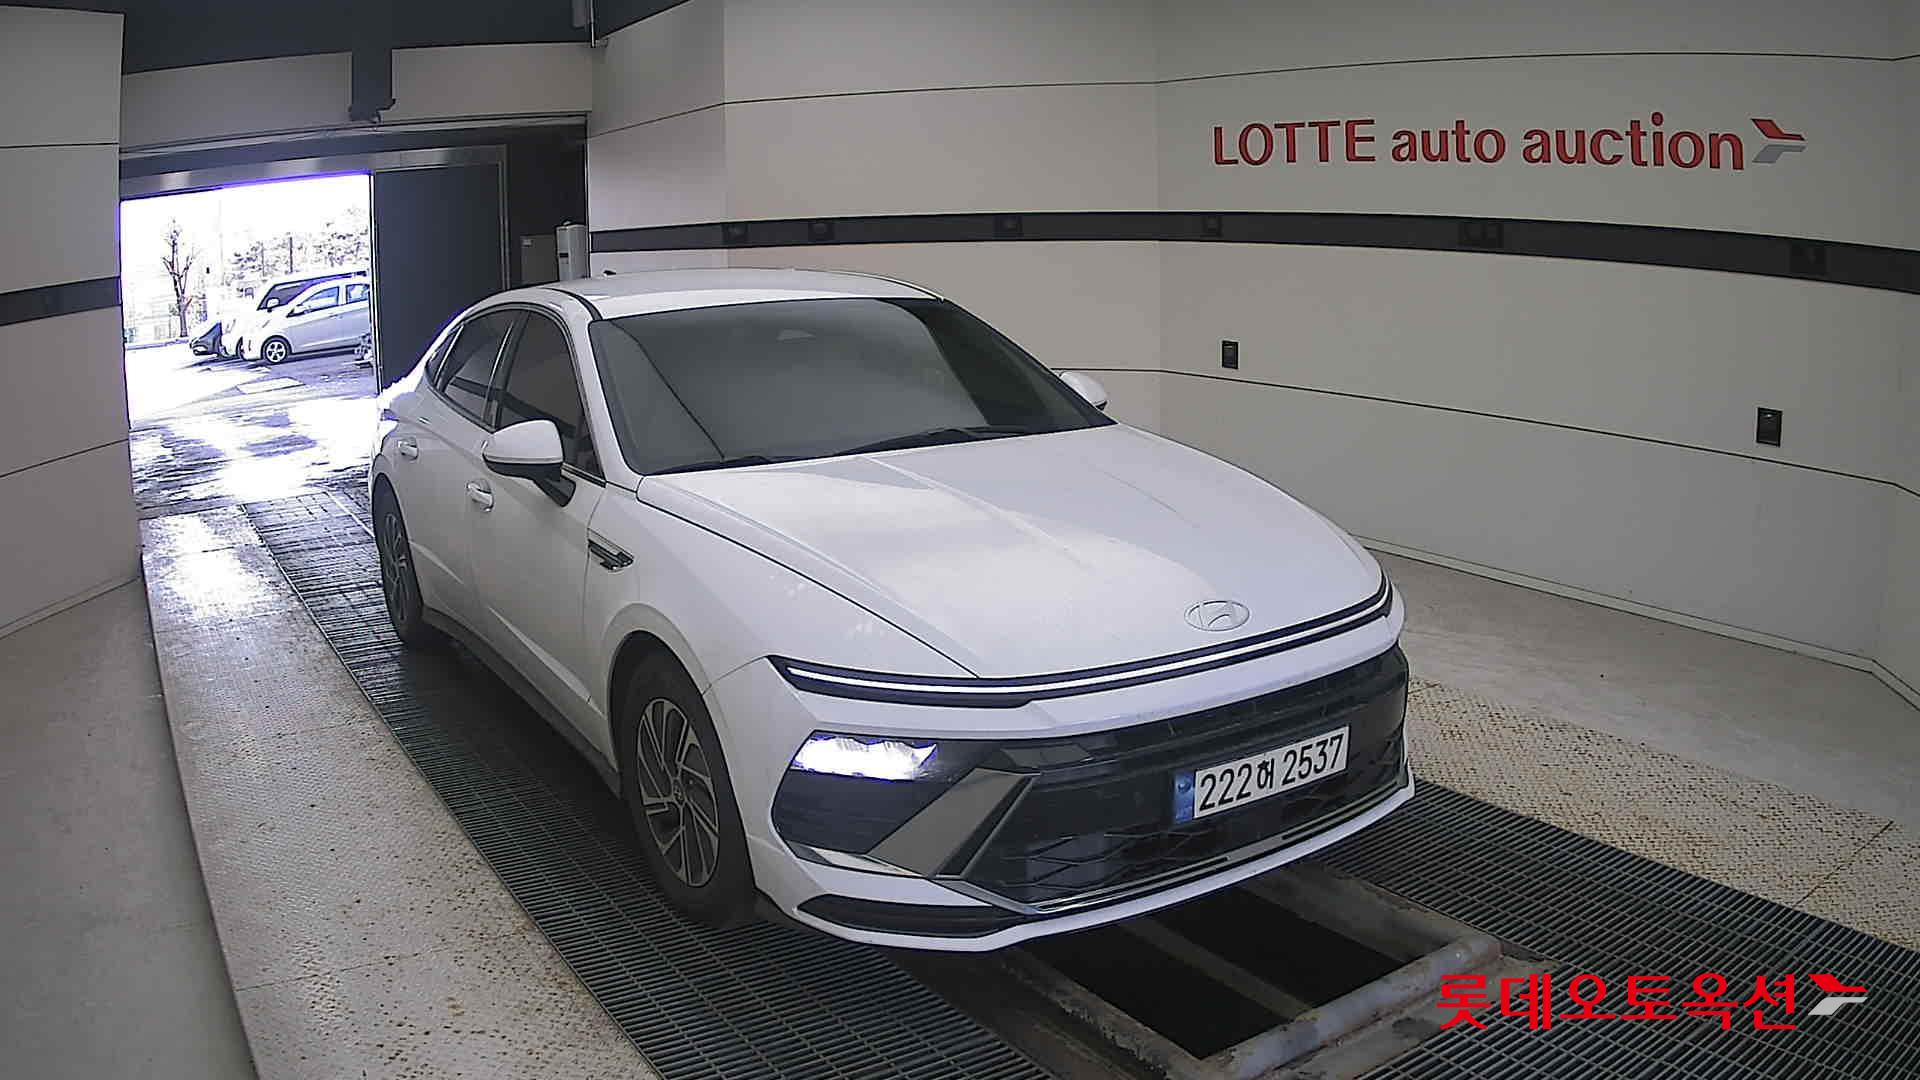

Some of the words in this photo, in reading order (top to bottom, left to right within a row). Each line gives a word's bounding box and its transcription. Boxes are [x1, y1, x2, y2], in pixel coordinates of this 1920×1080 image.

[1213, 119, 1376, 166] LOTTE
[1391, 119, 1507, 164] auto
[1522, 111, 1744, 171] auction
[1199, 757, 1275, 811] 222허
[1281, 733, 1344, 786] 2537
